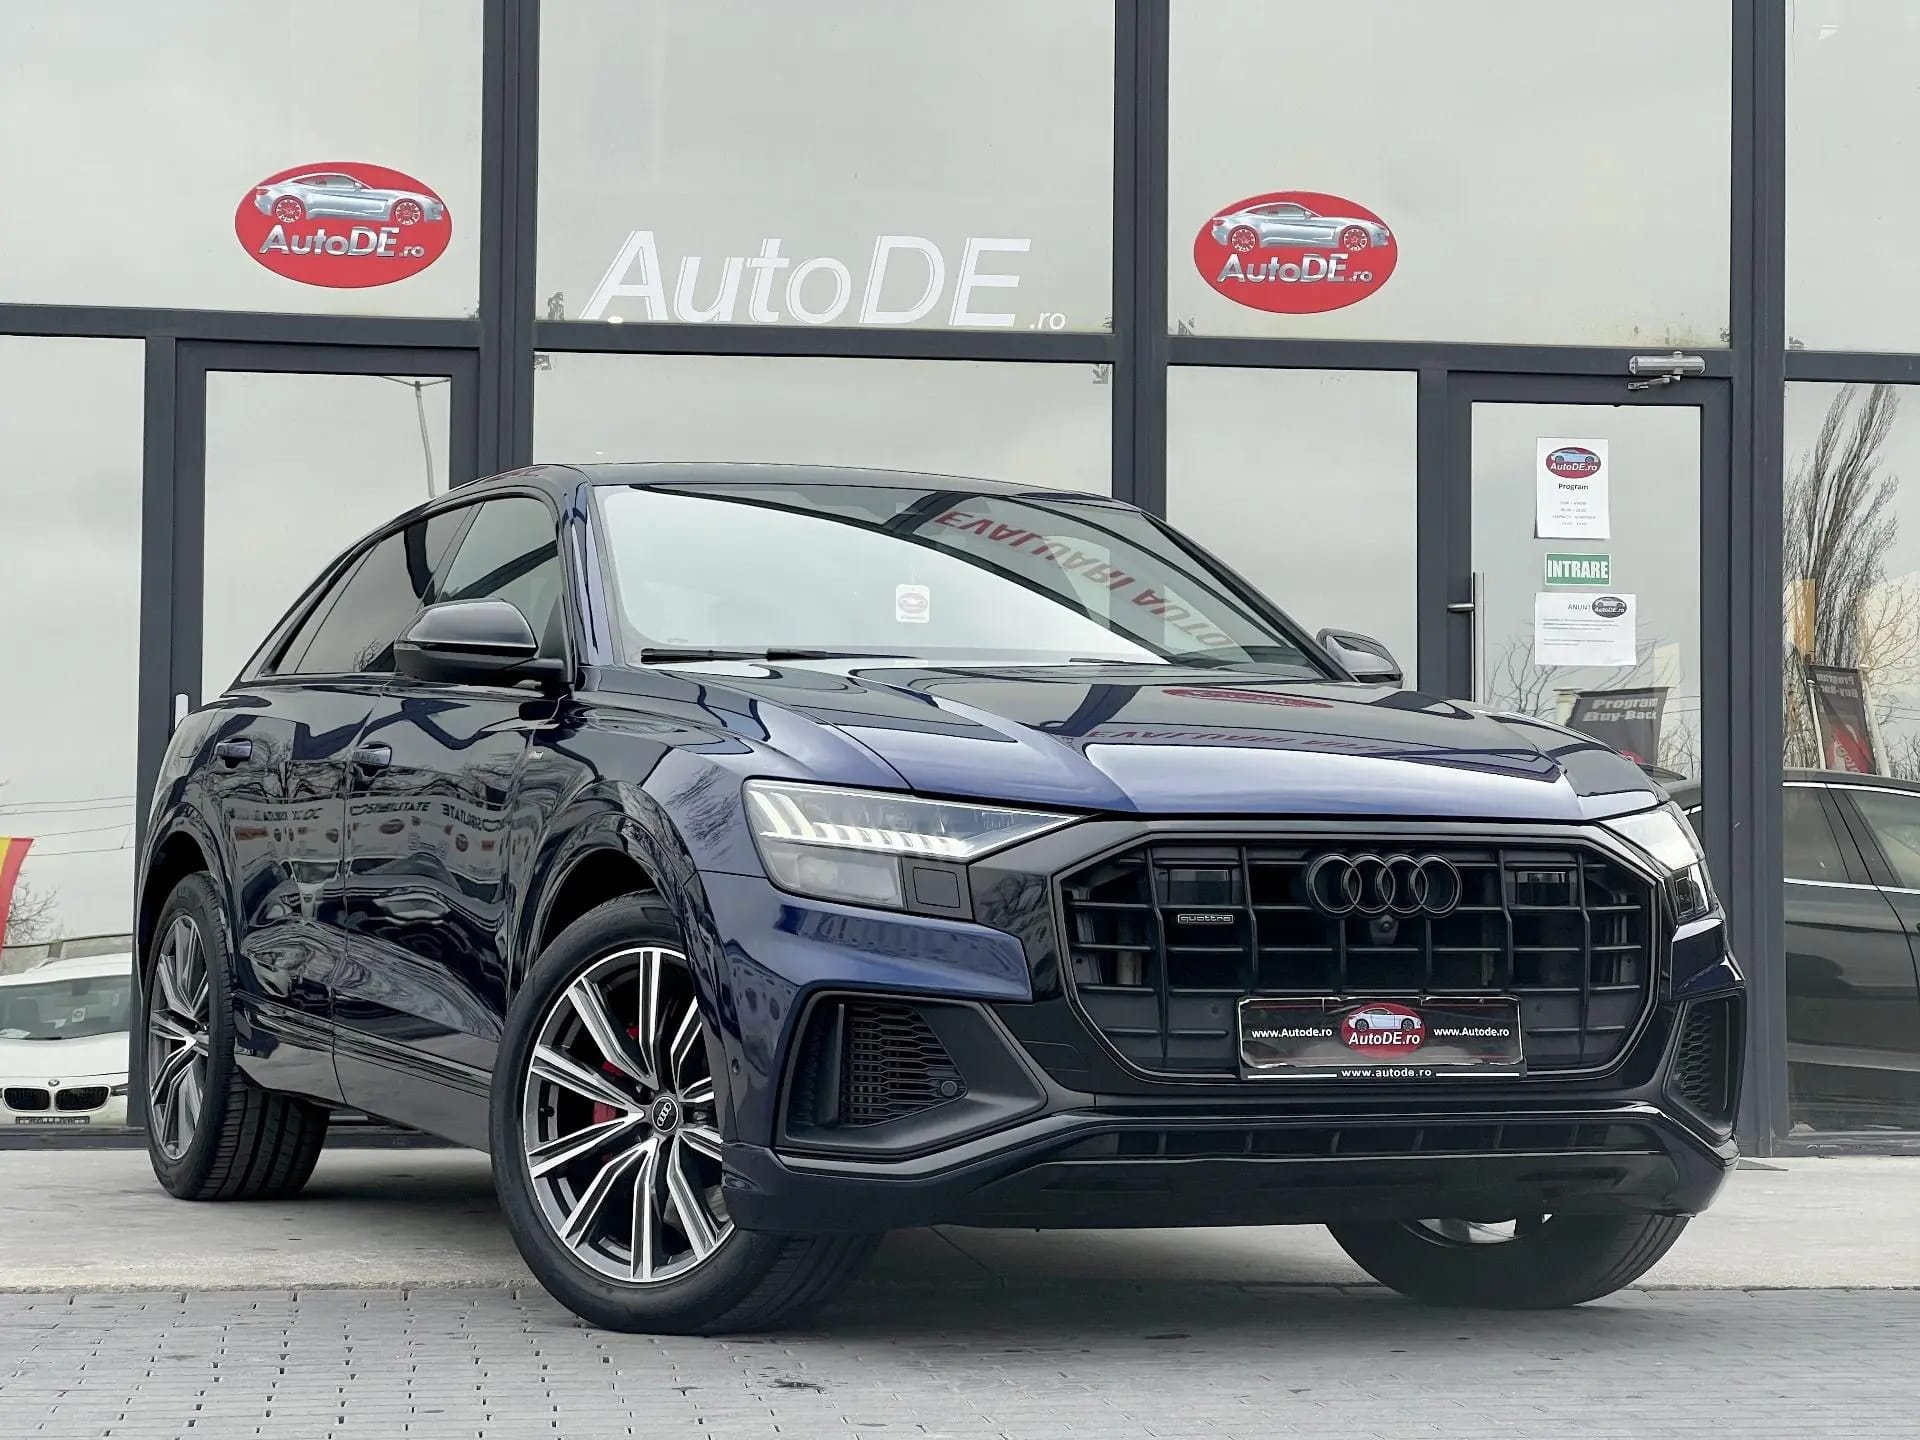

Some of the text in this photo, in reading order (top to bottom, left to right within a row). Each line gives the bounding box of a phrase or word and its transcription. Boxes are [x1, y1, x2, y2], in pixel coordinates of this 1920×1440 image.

[1558, 483, 1589, 491] Program
[1547, 559, 1609, 579] INTRARE
[1251, 1028, 1333, 1038] www.Autode.ro
[1434, 1027, 1510, 1037] www.Autode.ro
[1349, 1032, 1420, 1045] AutoDE.ro
[1341, 1068, 1432, 1077] www.autode.ro
